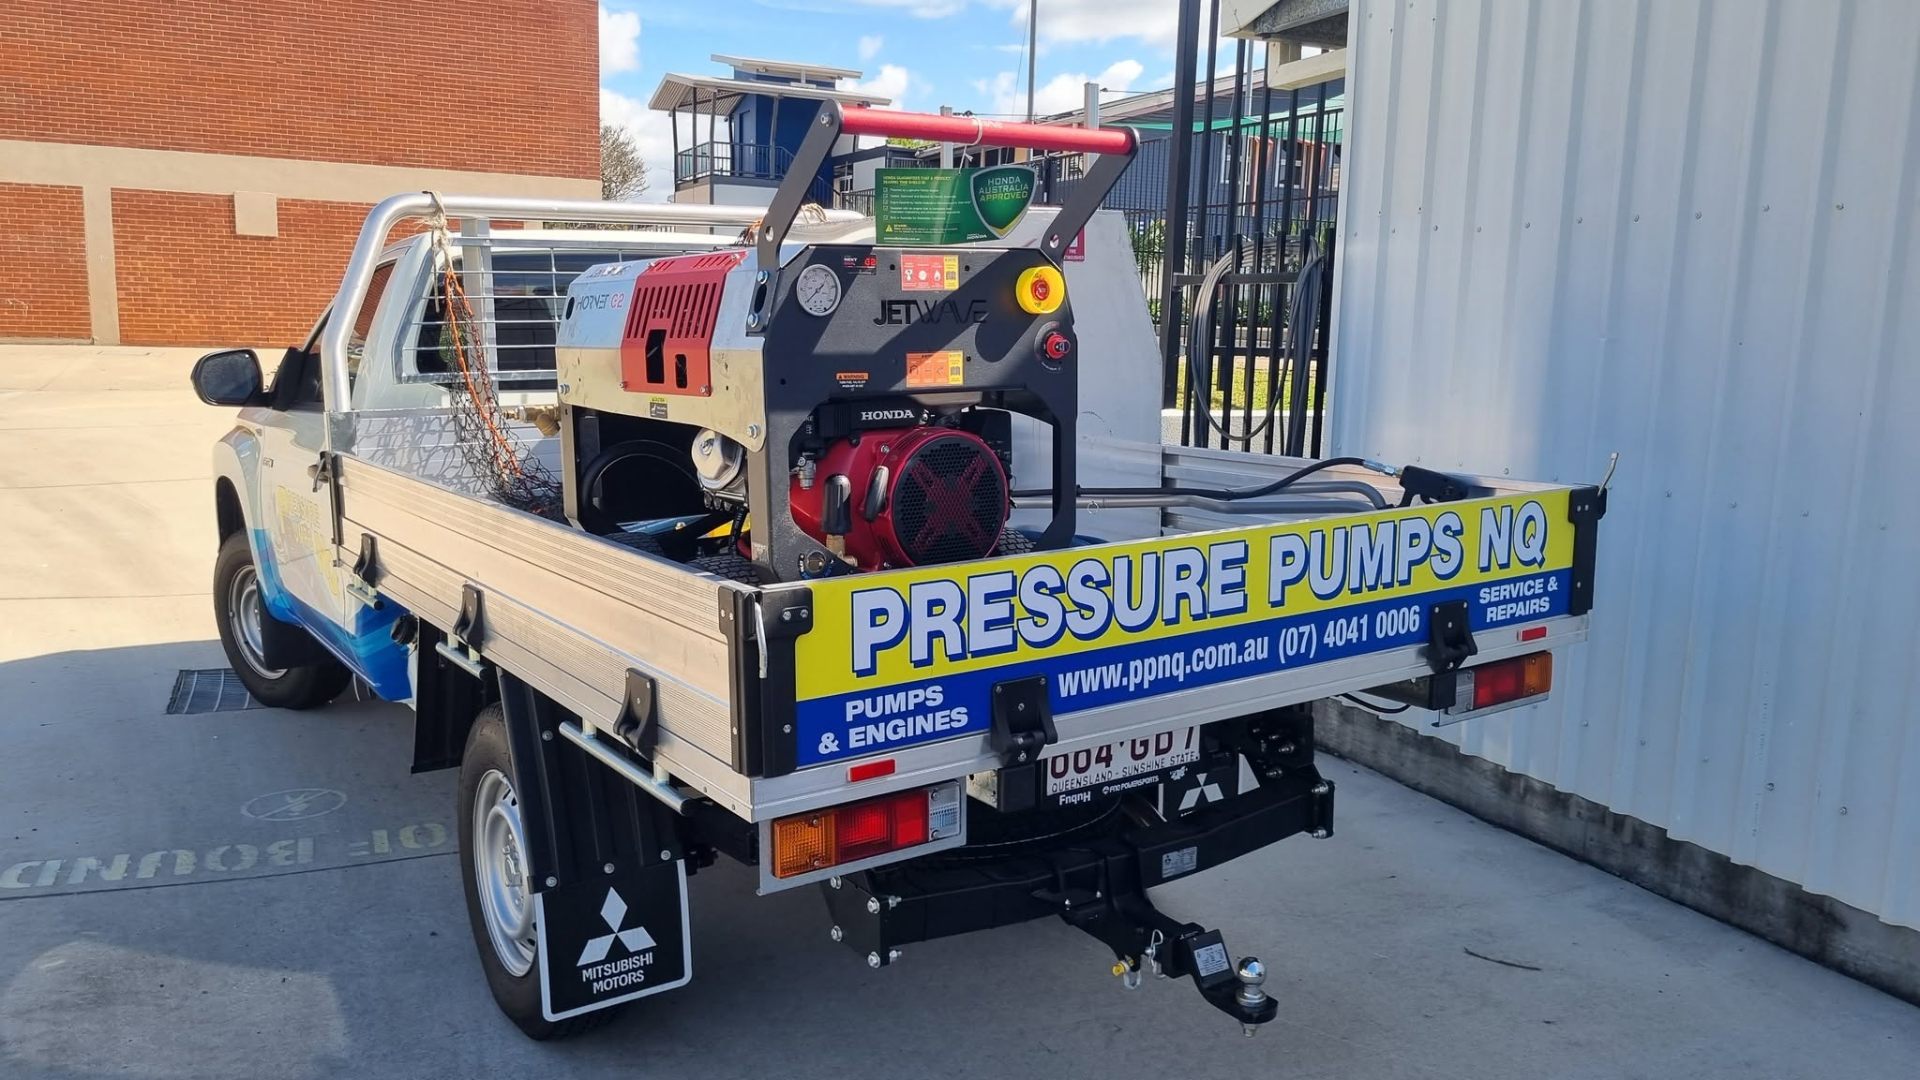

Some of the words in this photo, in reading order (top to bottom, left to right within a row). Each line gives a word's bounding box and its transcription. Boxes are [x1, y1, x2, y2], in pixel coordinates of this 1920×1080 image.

[979, 184, 1029, 195] AUSTRALIA
[987, 176, 1021, 185] HONDA
[979, 191, 1028, 202] APPROVED
[873, 299, 987, 326] JETWAVE
[861, 409, 915, 421] HONDA
[851, 539, 1249, 678] PRESSURE
[1268, 511, 1464, 608] PUMPS
[1478, 500, 1548, 573] NQ
[1479, 579, 1544, 604] SERVICE
[1547, 576, 1559, 592] &
[1486, 597, 1551, 623] REPAIRS
[1058, 634, 1269, 698] www.ppnq.com.au
[1278, 623, 1317, 664] (07)
[1324, 614, 1368, 649] 4041
[1376, 605, 1420, 640] 0006
[845, 685, 944, 722] PUMPS
[818, 732, 839, 755] &
[848, 706, 969, 750] ENGINES
[1051, 771, 1113, 793] QUEENSLAND
[1122, 757, 1165, 777] SUNSHINE
[1170, 752, 1194, 764] STATE
[1120, 775, 1159, 791] POWERSPORTS
[582, 952, 653, 982] MITSUBISHI
[592, 970, 645, 994] MOTORS
